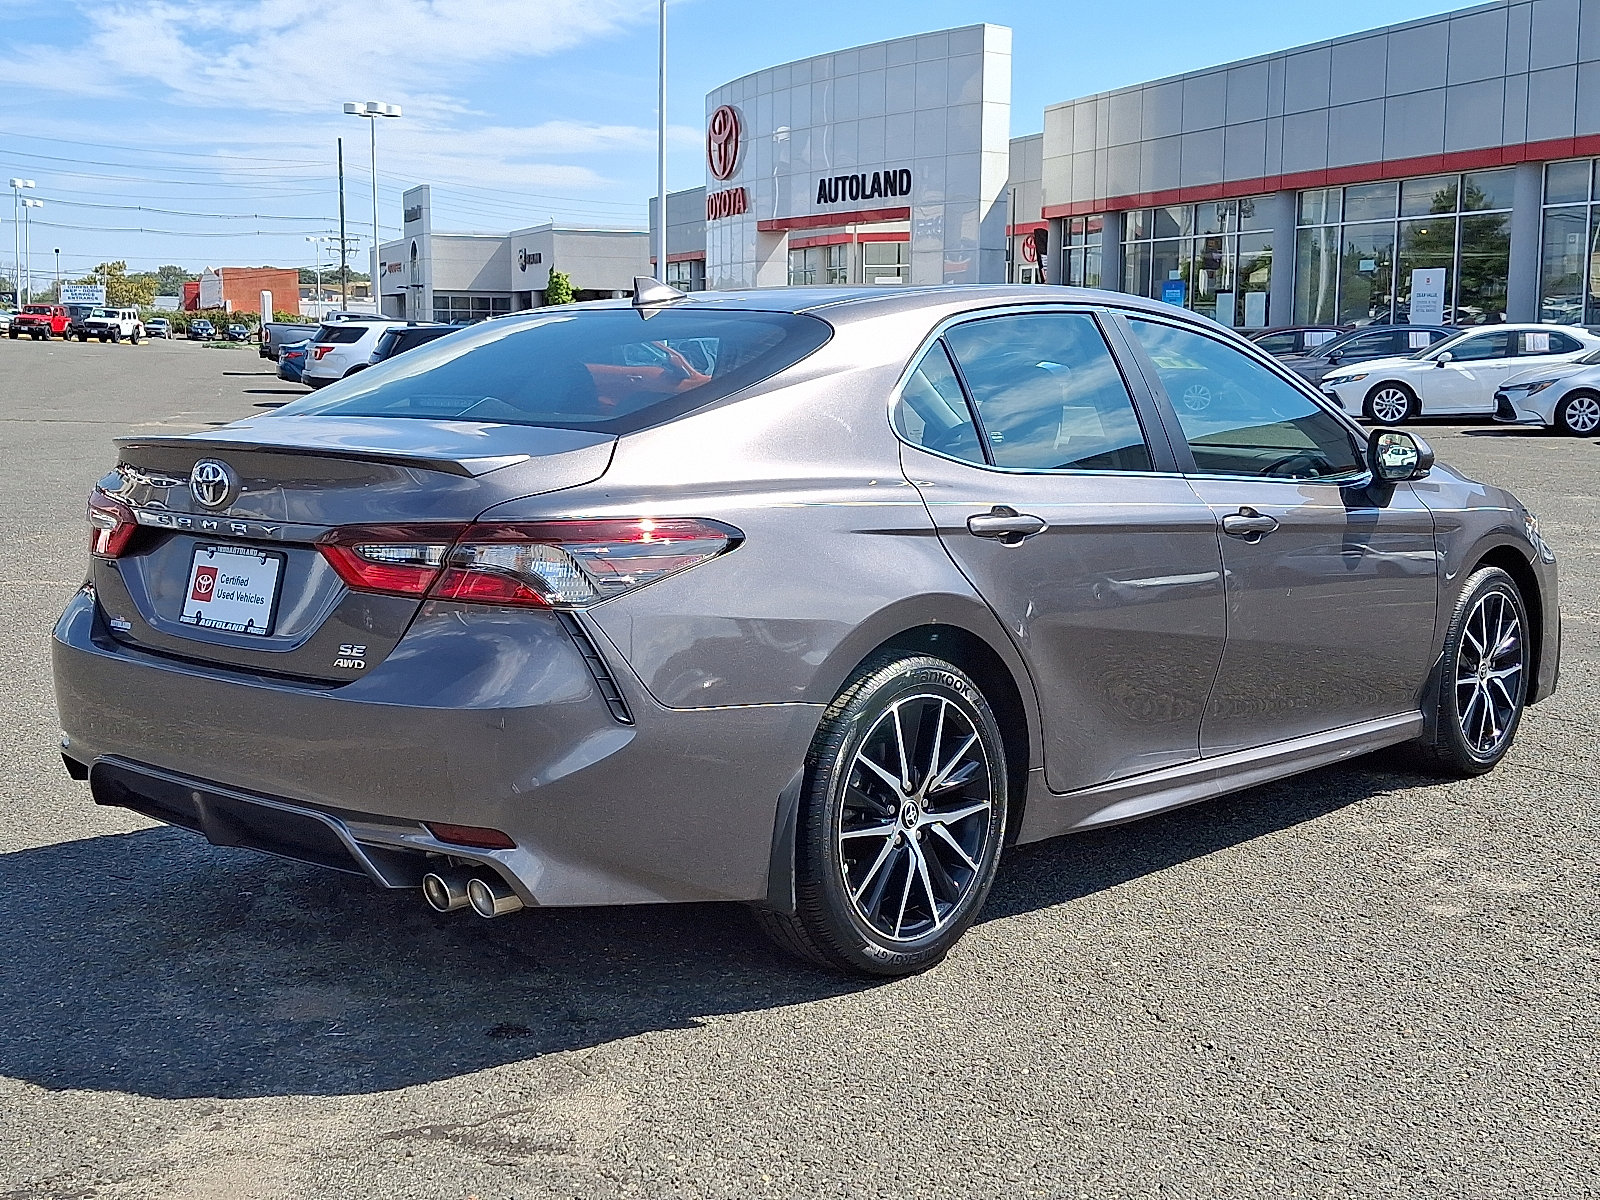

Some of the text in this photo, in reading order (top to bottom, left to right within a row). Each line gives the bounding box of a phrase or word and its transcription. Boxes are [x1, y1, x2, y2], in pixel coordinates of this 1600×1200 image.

[816, 168, 912, 205] AUTOLAND
[156, 513, 281, 536] CAMRY
[220, 573, 250, 587] Certified
[216, 588, 265, 605] Used Vehicles
[199, 619, 246, 632] AUTOLAND
[337, 644, 368, 657] SE
[332, 658, 366, 669] AWD
[907, 669, 971, 698] ankook
